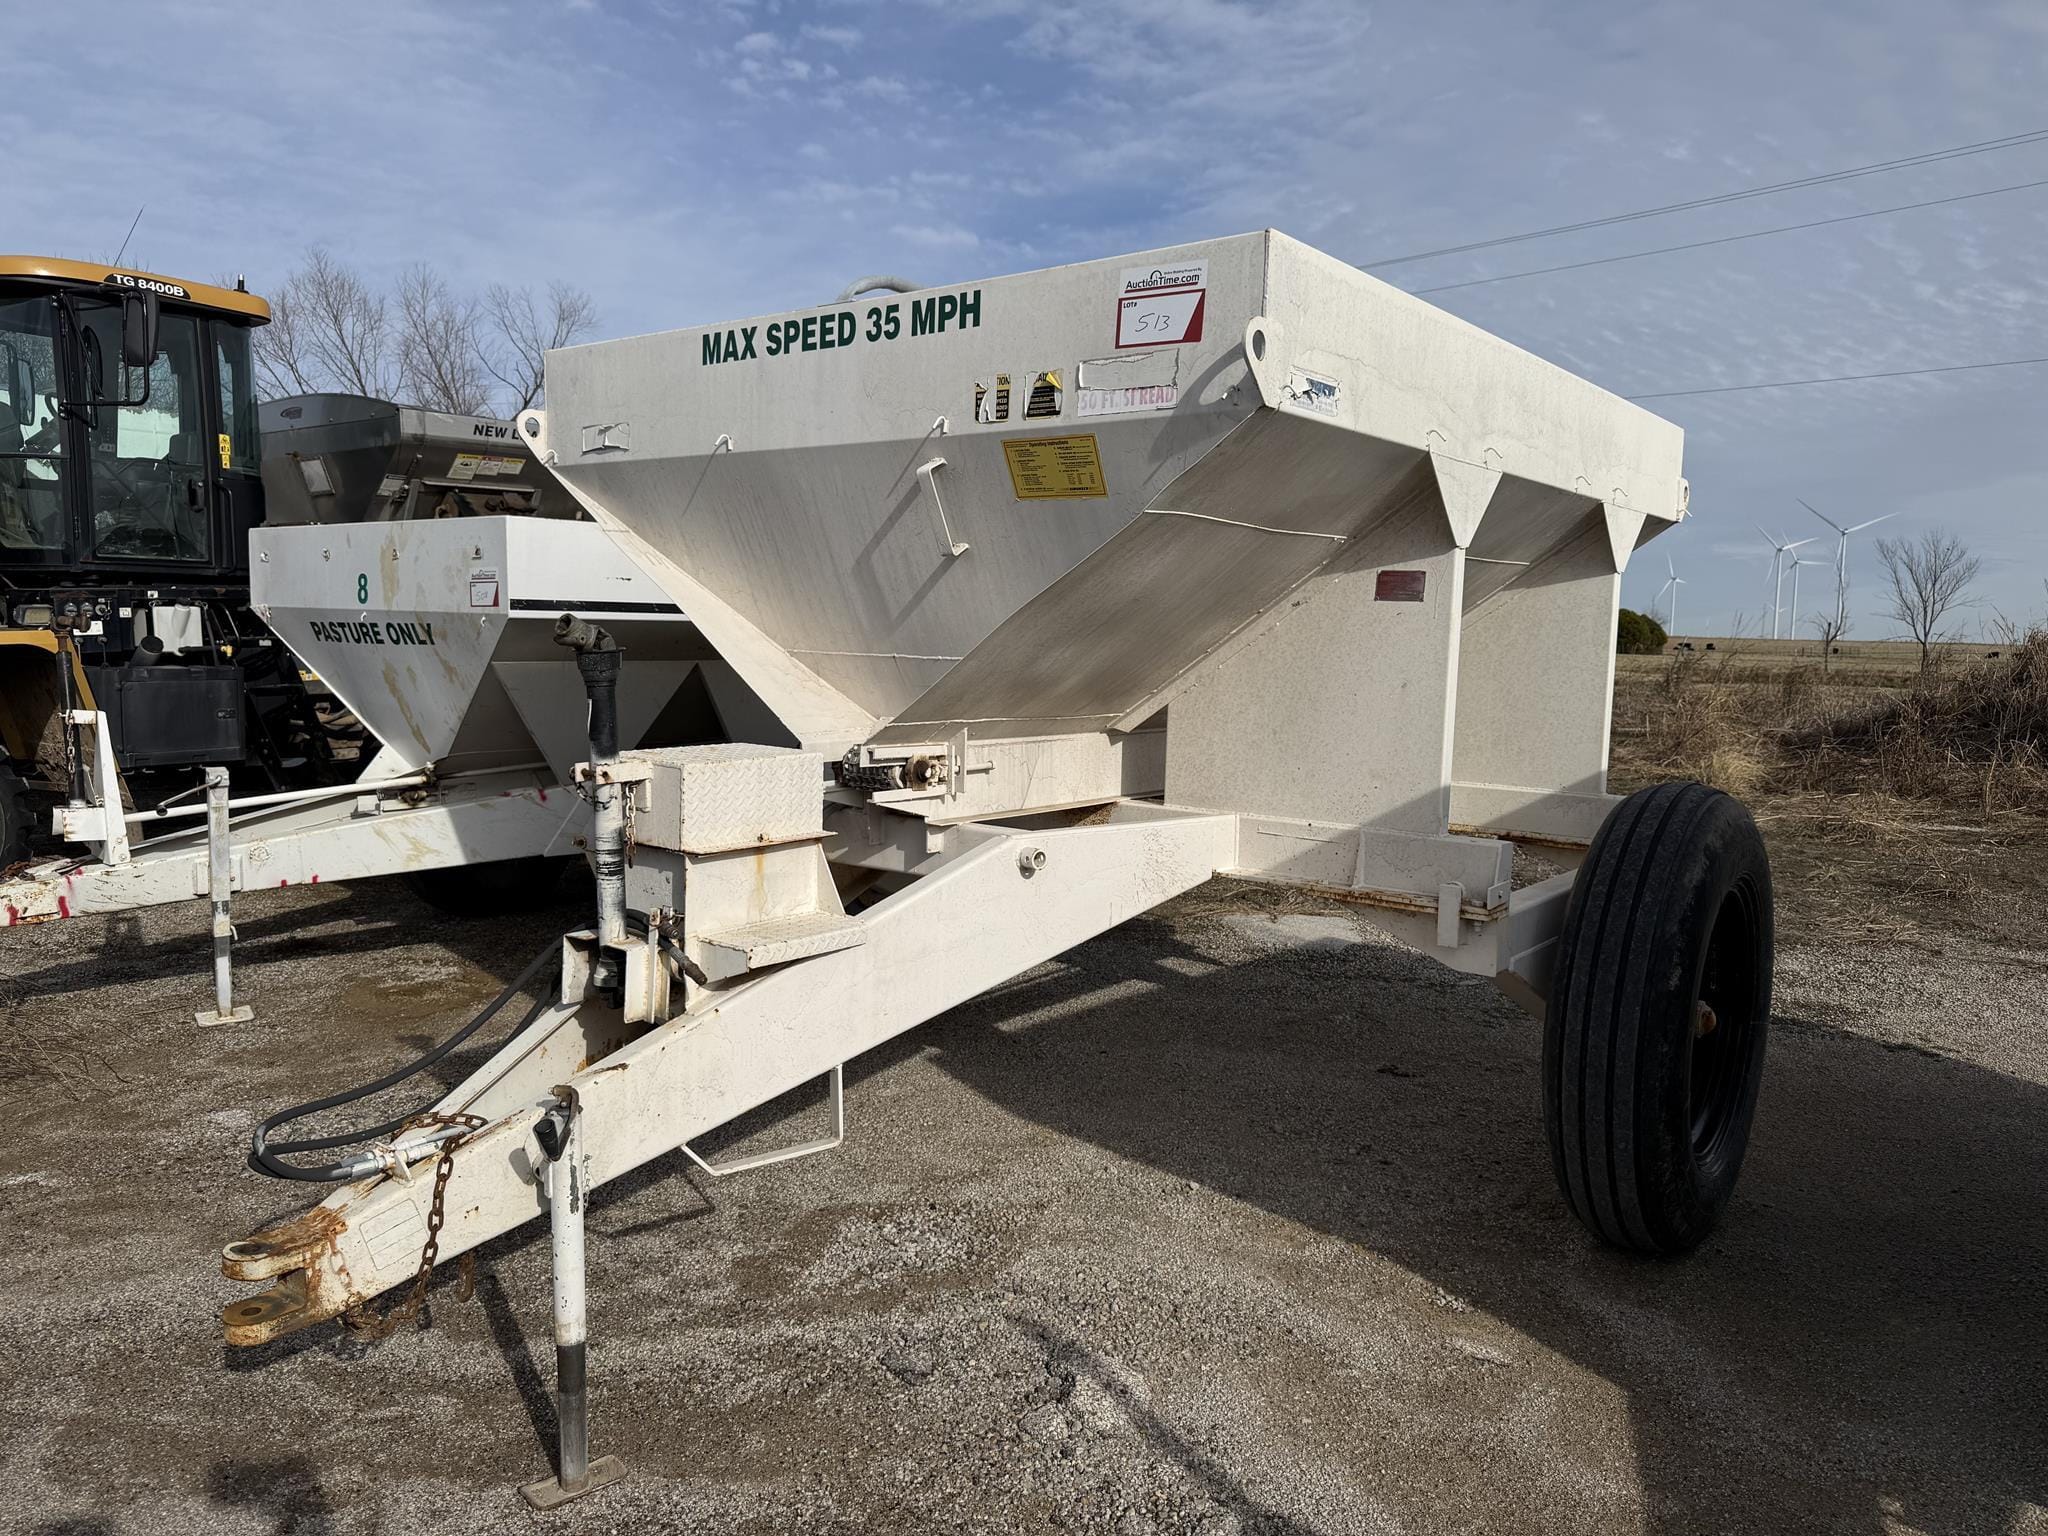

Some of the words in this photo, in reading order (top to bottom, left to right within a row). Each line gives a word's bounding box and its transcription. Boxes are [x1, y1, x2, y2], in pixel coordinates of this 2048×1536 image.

[113, 274, 135, 287] TG
[138, 279, 184, 297] 8400B
[1126, 273, 1200, 289] AuctionTime.com
[702, 326, 758, 366] MAX
[766, 311, 857, 357] SPEED
[866, 303, 901, 343] 35
[911, 289, 981, 337] MPH
[1135, 313, 1170, 332] 513
[473, 424, 508, 438] NEW
[358, 573, 368, 604] 8
[310, 621, 385, 644] PASTURE
[385, 622, 436, 645] ONLY
